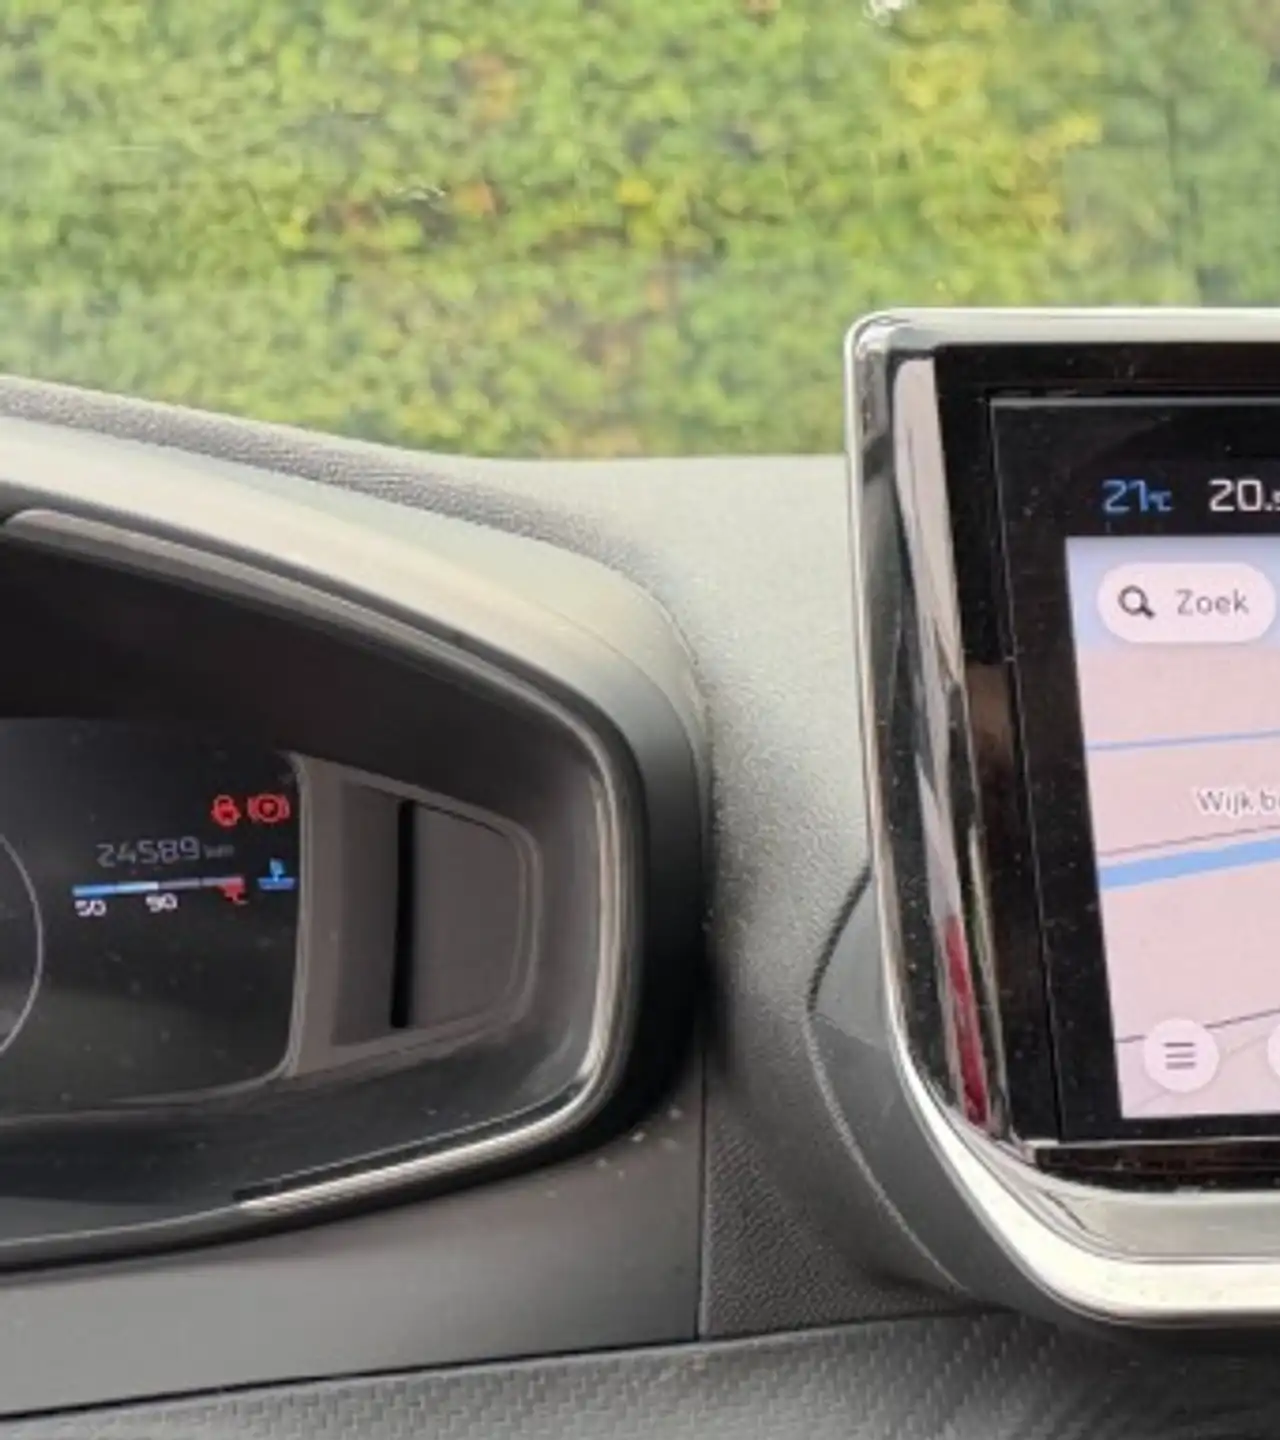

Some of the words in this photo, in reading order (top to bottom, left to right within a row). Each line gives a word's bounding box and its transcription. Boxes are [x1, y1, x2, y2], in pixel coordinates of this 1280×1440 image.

[1175, 588, 1249, 616] Zoek
[1196, 788, 1254, 816] Wijk
[97, 836, 200, 868] 24589
[74, 898, 107, 917] 50
